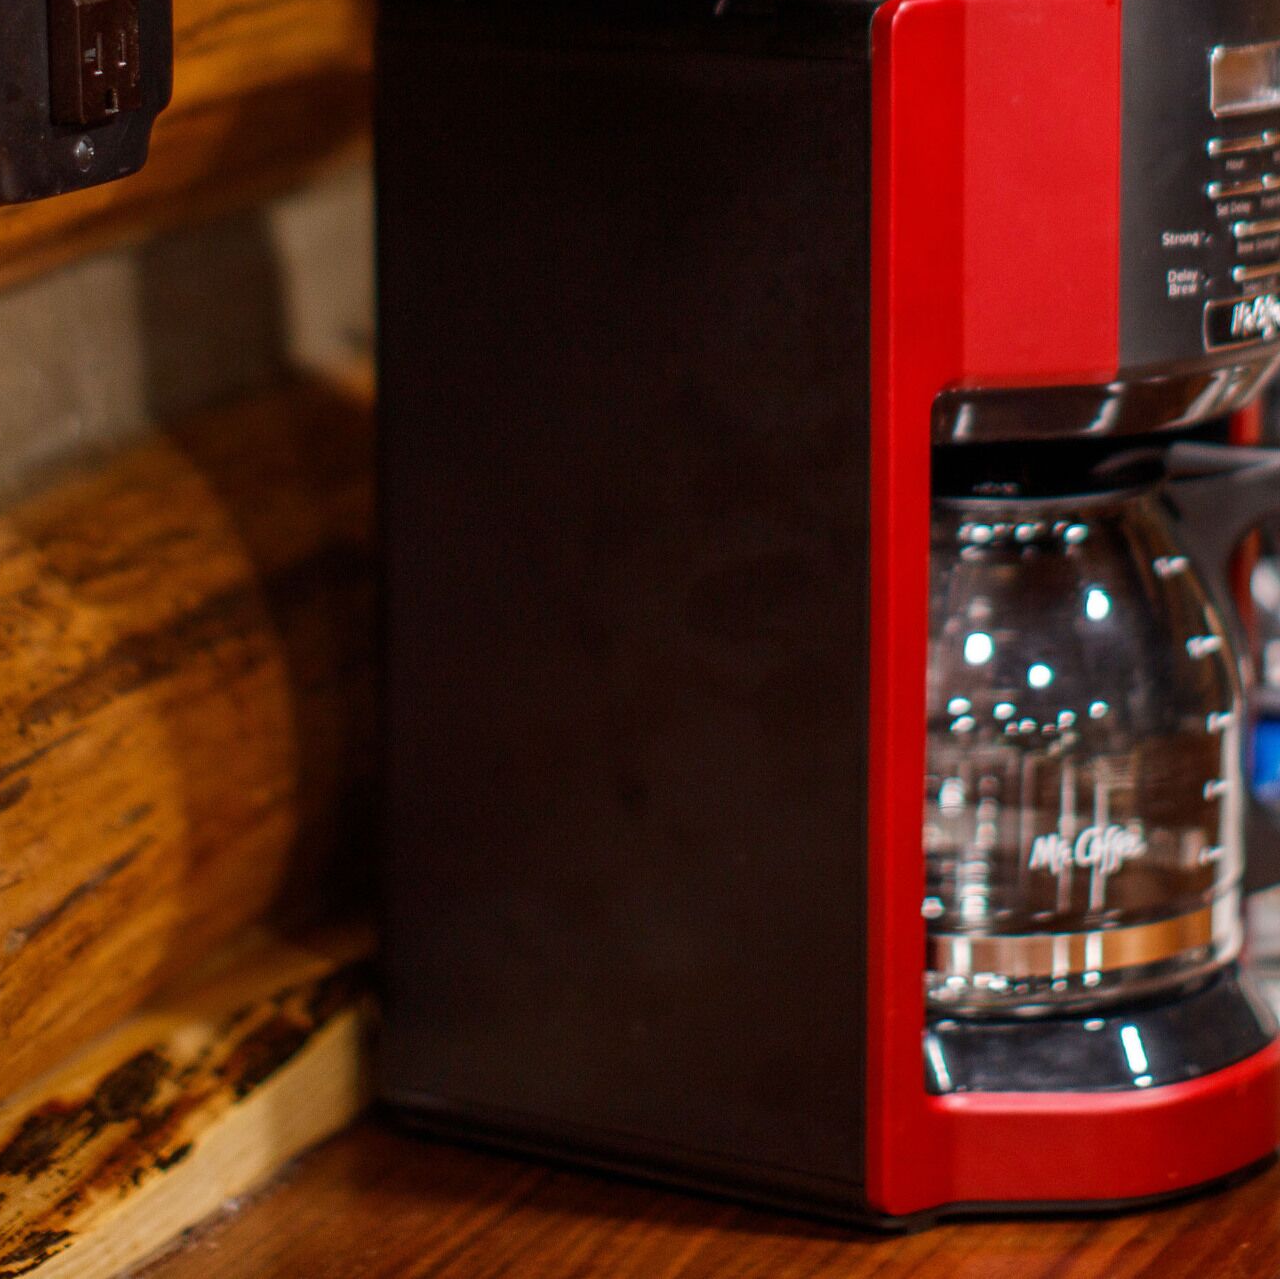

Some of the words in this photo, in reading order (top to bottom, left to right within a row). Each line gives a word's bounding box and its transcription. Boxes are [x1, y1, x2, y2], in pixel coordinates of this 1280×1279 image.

[1161, 231, 1199, 247] Strong
[1167, 269, 1198, 285] Delay
[1168, 283, 1197, 298] Brew
